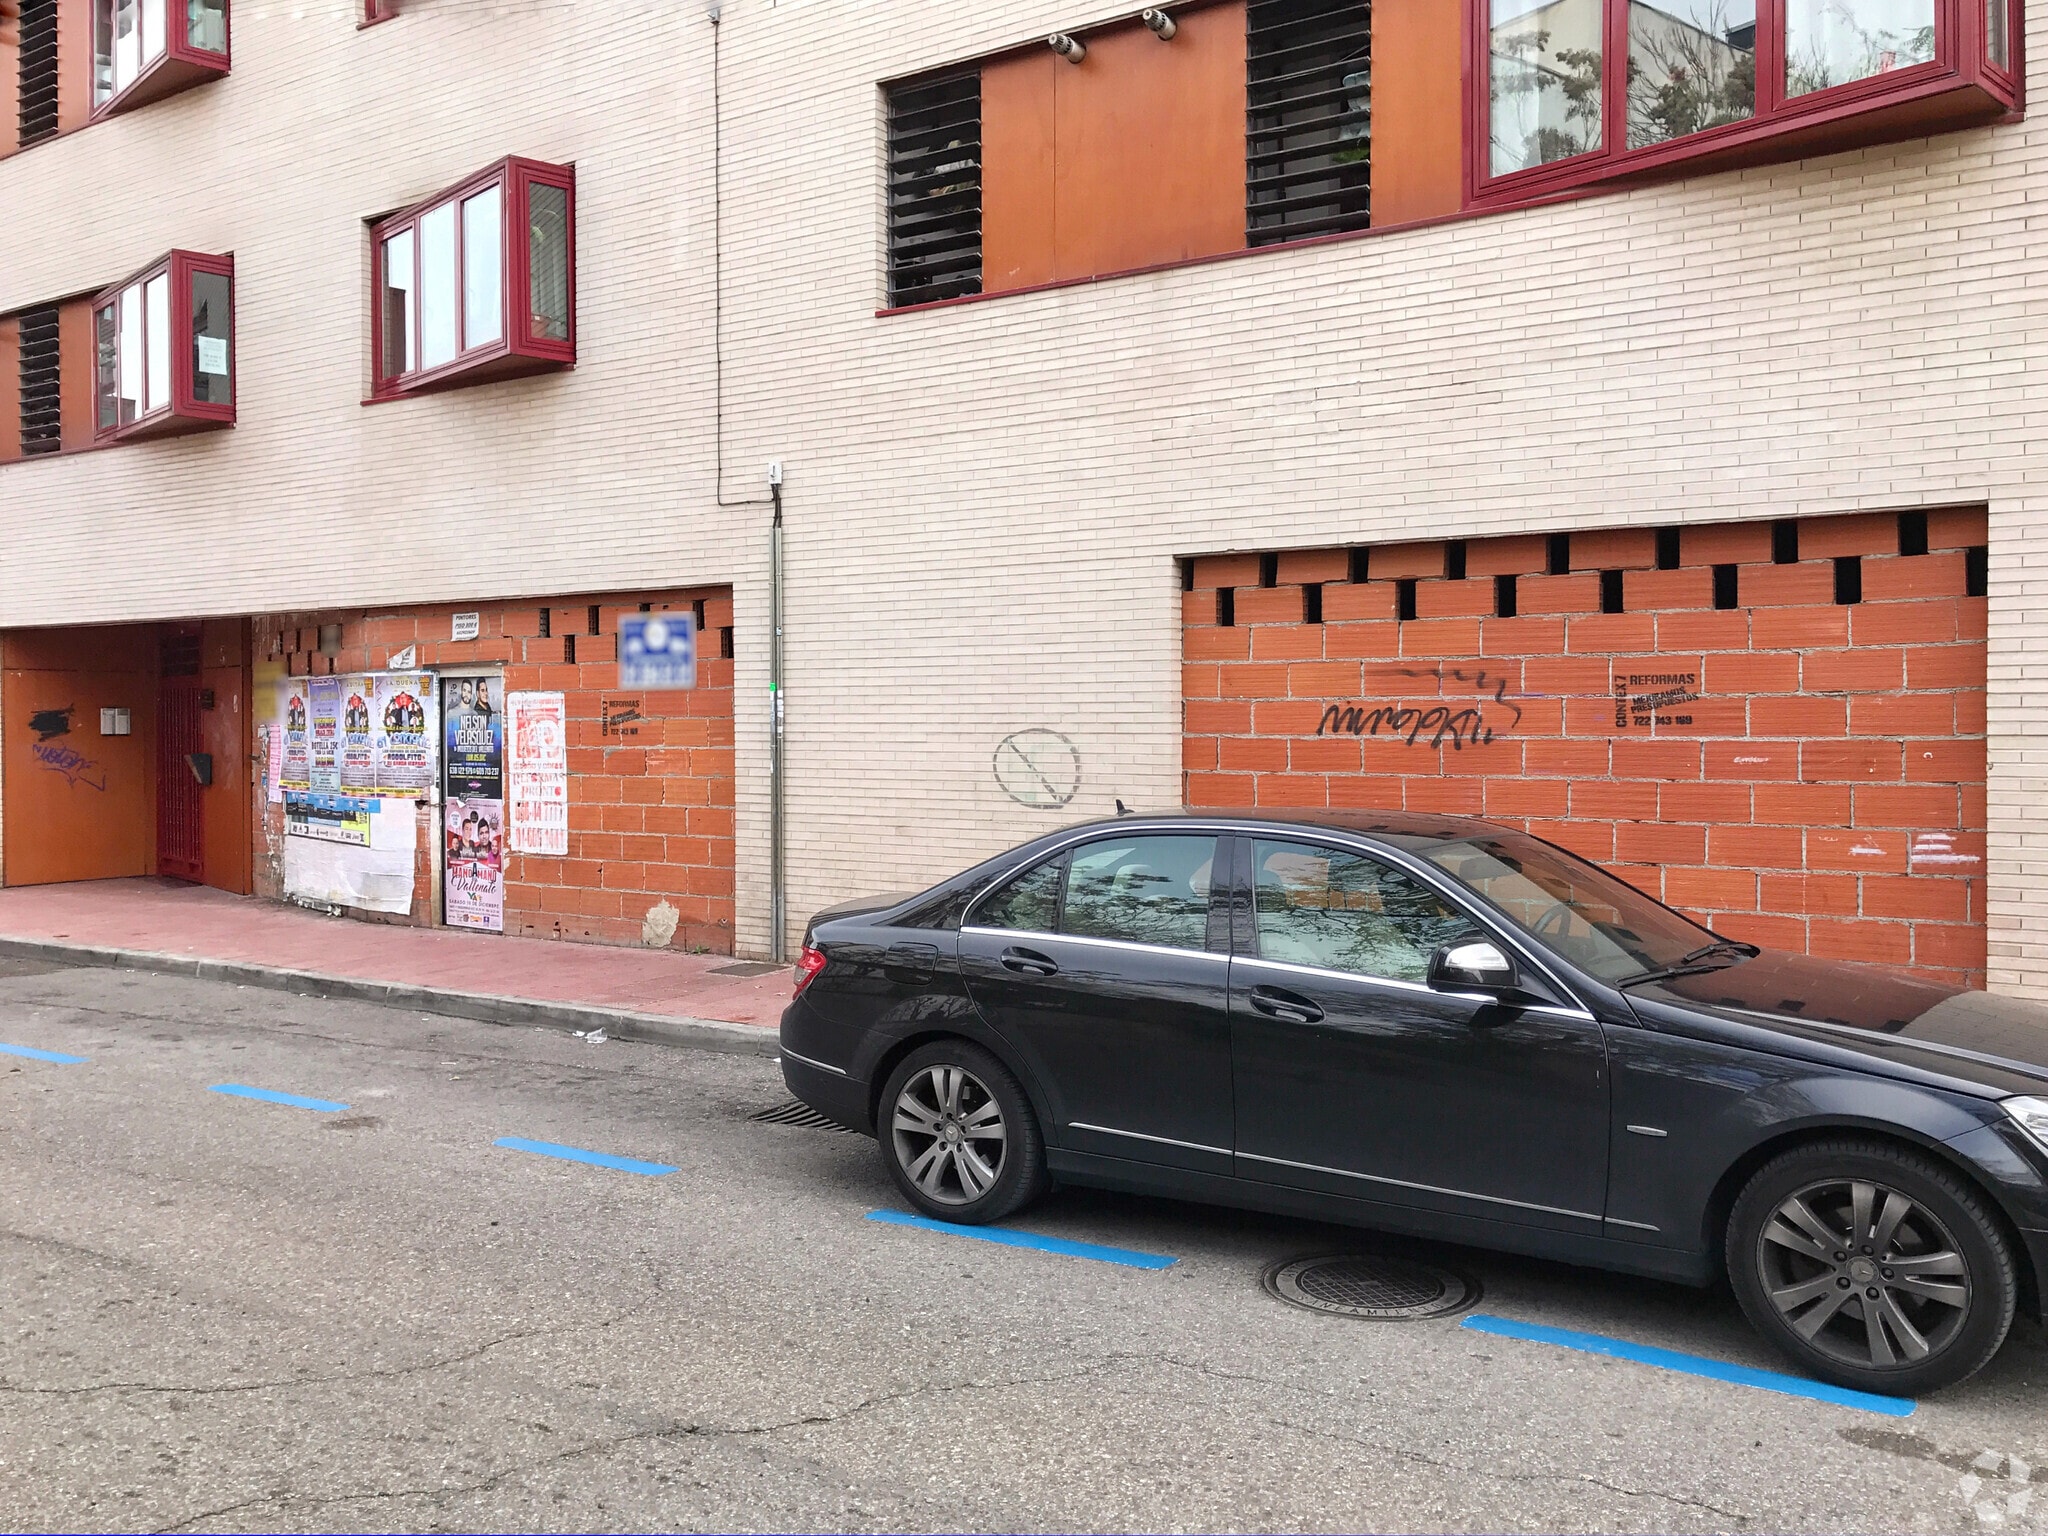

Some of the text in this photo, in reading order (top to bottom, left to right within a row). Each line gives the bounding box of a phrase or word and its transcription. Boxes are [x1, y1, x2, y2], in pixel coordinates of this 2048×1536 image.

[1630, 673, 1695, 685] REFORMAS
[1630, 692, 1699, 714] PRESUPUESTOS
[1632, 686, 1686, 706] MEJORAMOS
[1615, 683, 1627, 728] CONTEX
[460, 715, 487, 730] NELSON
[1633, 715, 1651, 726] 722
[454, 730, 494, 745] VELASQUEZ
[513, 772, 565, 785] REFORMAS
[521, 785, 562, 799] PRONTO
